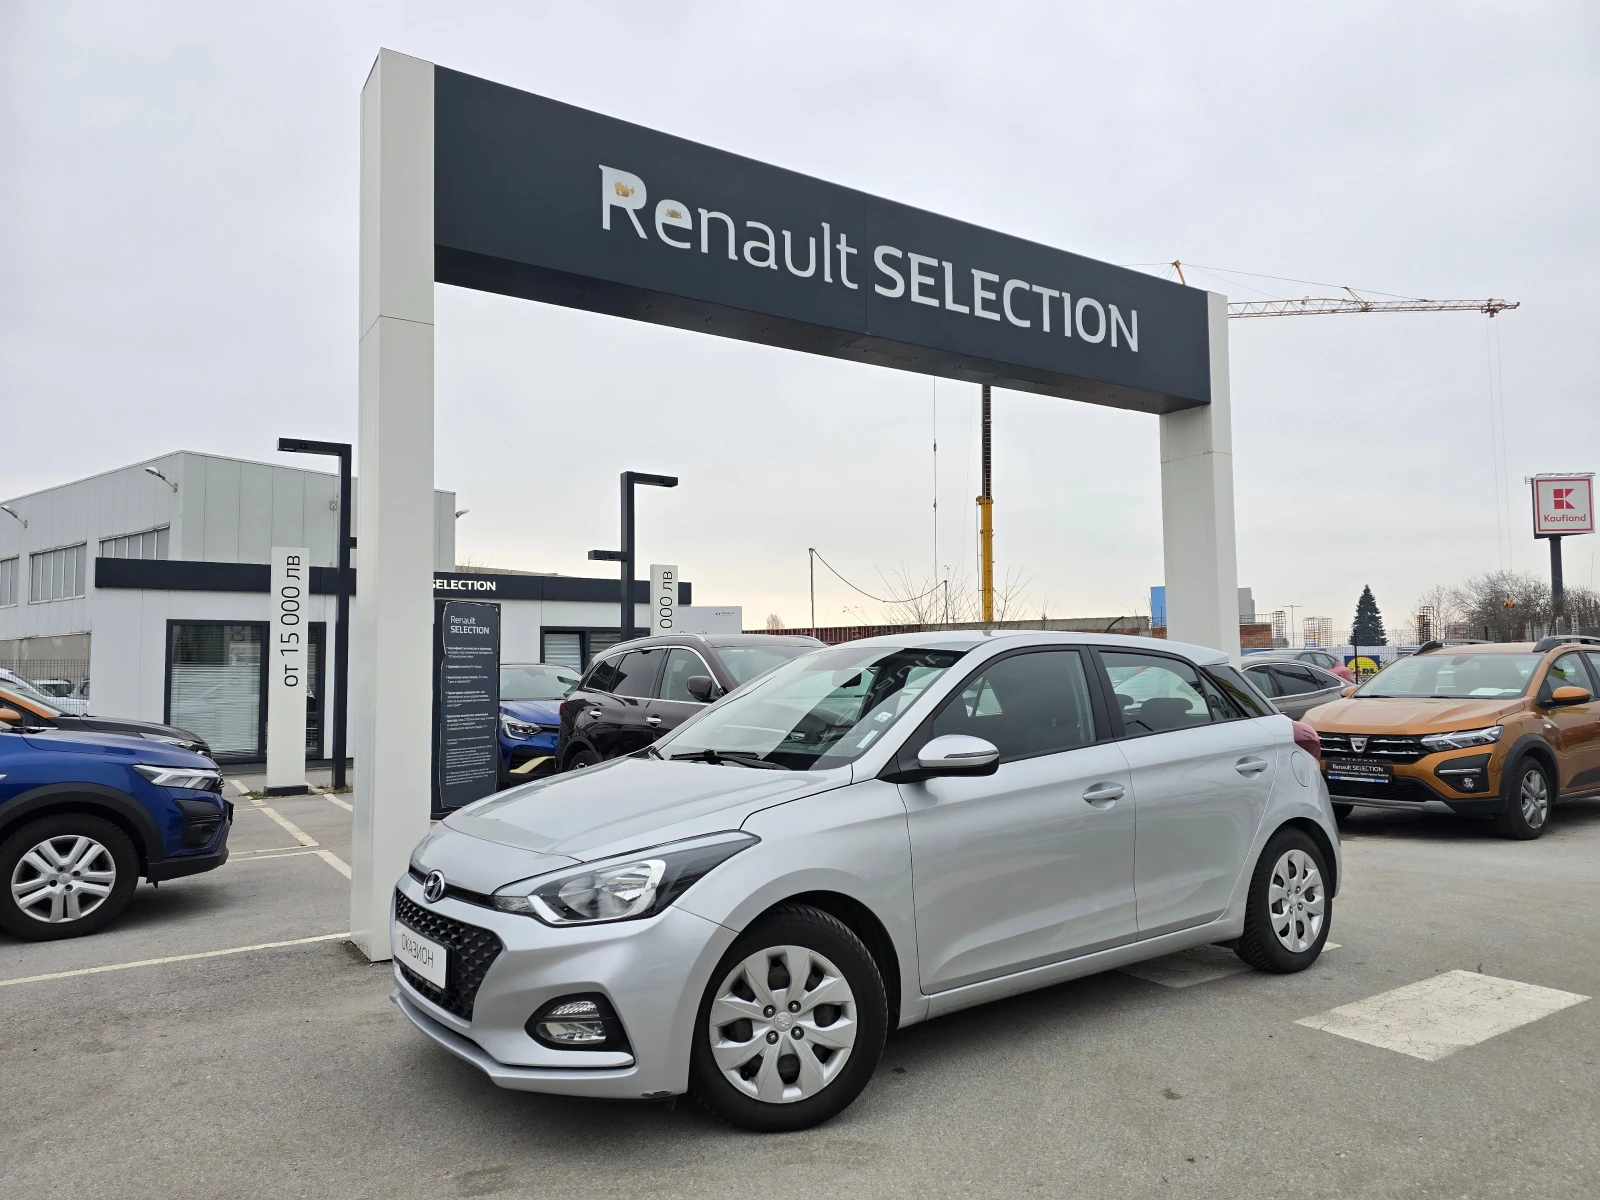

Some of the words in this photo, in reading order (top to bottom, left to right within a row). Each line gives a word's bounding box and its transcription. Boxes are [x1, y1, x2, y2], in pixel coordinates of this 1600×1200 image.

[598, 164, 858, 290] Renault
[874, 245, 1139, 352] SELECTION
[1544, 514, 1586, 522] Kaufland
[281, 586, 300, 626] 000
[660, 596, 673, 629] 000
[450, 615, 476, 625] Renault
[450, 625, 490, 635] SELECTION
[280, 632, 299, 656] 15
[1332, 763, 1352, 771] Renault
[1352, 764, 1384, 773] SELECTION
